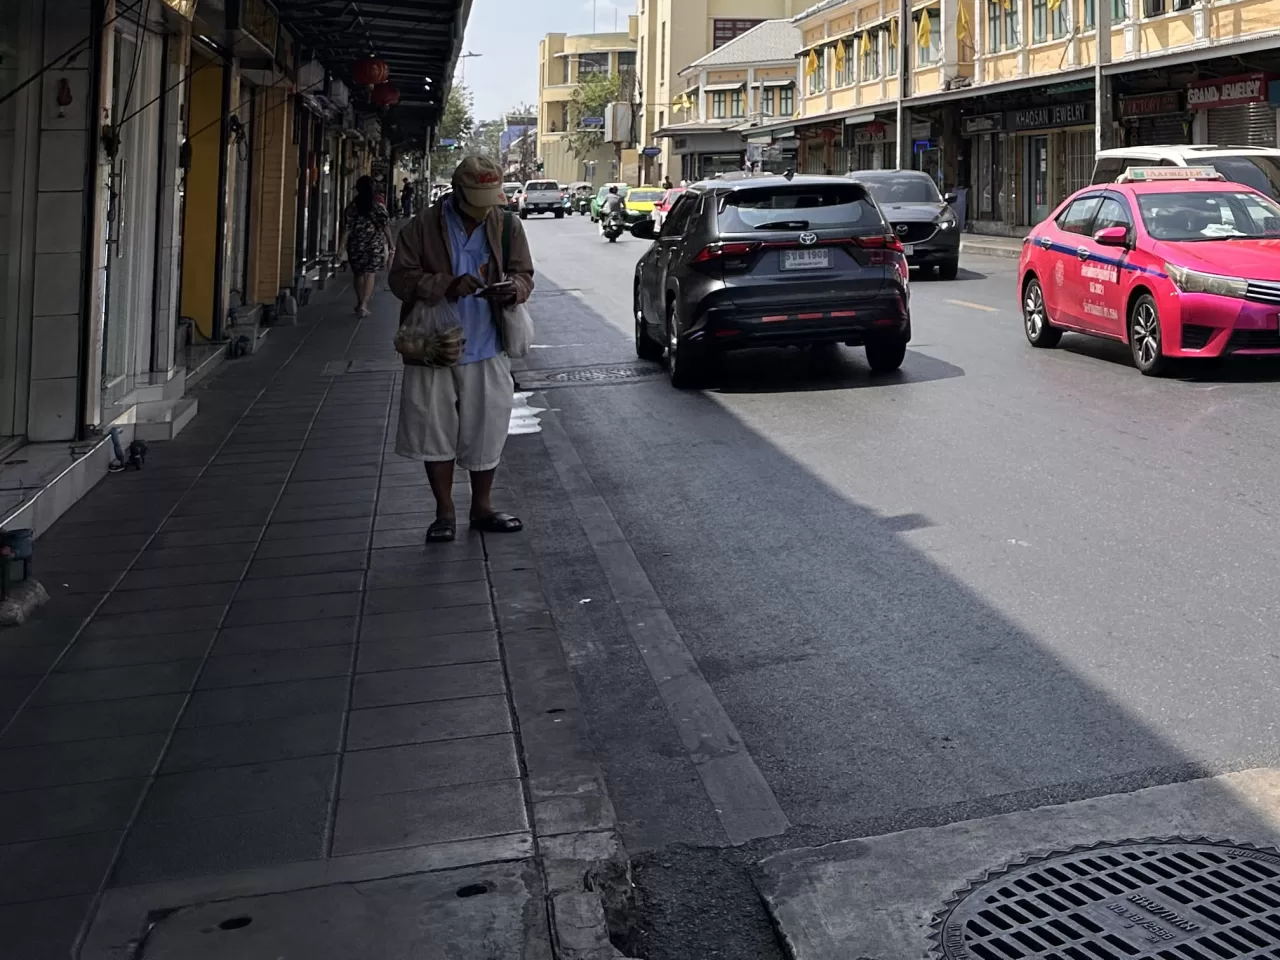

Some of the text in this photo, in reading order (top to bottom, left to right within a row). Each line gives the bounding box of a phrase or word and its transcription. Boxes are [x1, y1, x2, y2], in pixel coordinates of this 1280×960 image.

[1188, 86, 1220, 105] GRAND
[1015, 109, 1048, 127] KHAOSAN
[1052, 104, 1085, 123] JEWELRY
